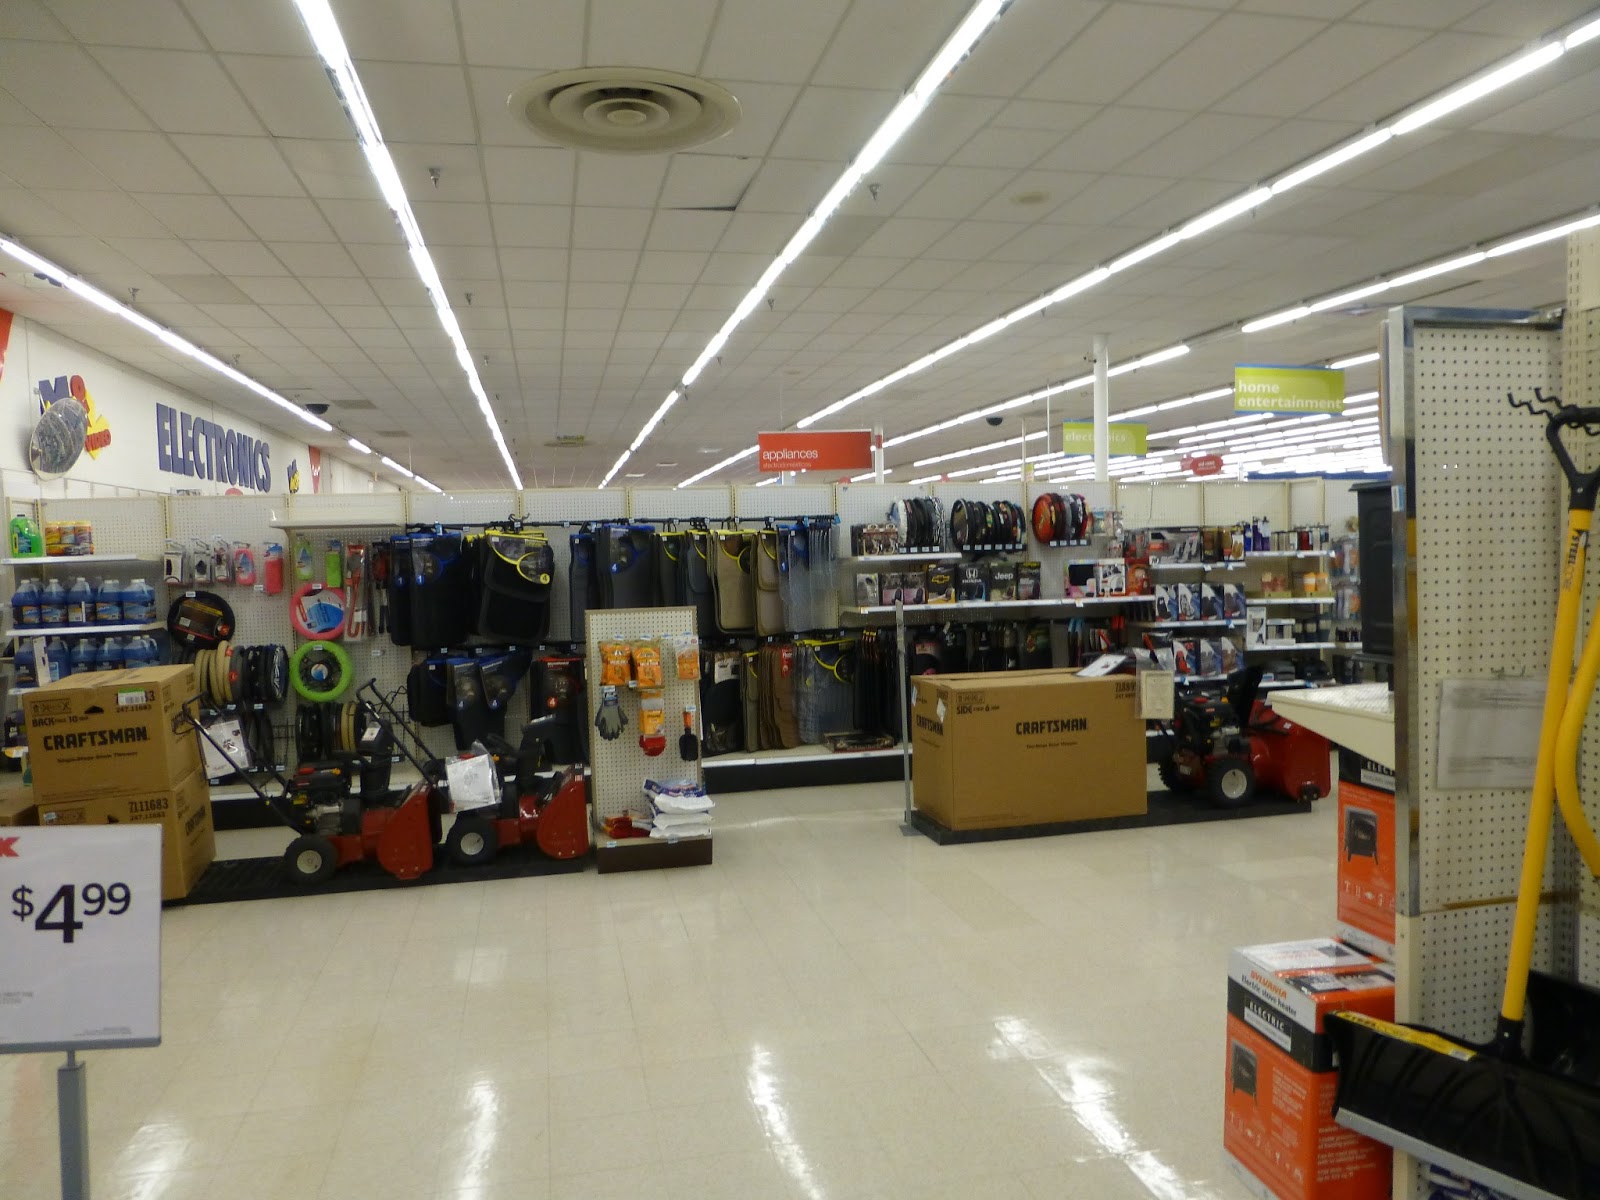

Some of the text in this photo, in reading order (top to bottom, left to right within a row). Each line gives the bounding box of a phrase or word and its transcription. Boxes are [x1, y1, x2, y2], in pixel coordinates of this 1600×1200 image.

[1238, 380, 1280, 394] home
[1238, 395, 1343, 410] entertainment
[156, 402, 271, 493] ELECTRONICS
[762, 448, 819, 462] appliances
[994, 572, 1014, 581] Jeep
[956, 704, 973, 715] SIDE
[31, 717, 55, 728] BACK
[1015, 717, 1087, 736] CRAFTSMAN
[43, 726, 148, 752] CRAFTSMAN
[127, 798, 169, 814] 7111683
[1250, 969, 1287, 1000] SYLVANIA
[1249, 1000, 1285, 1032] ELECTRIC
